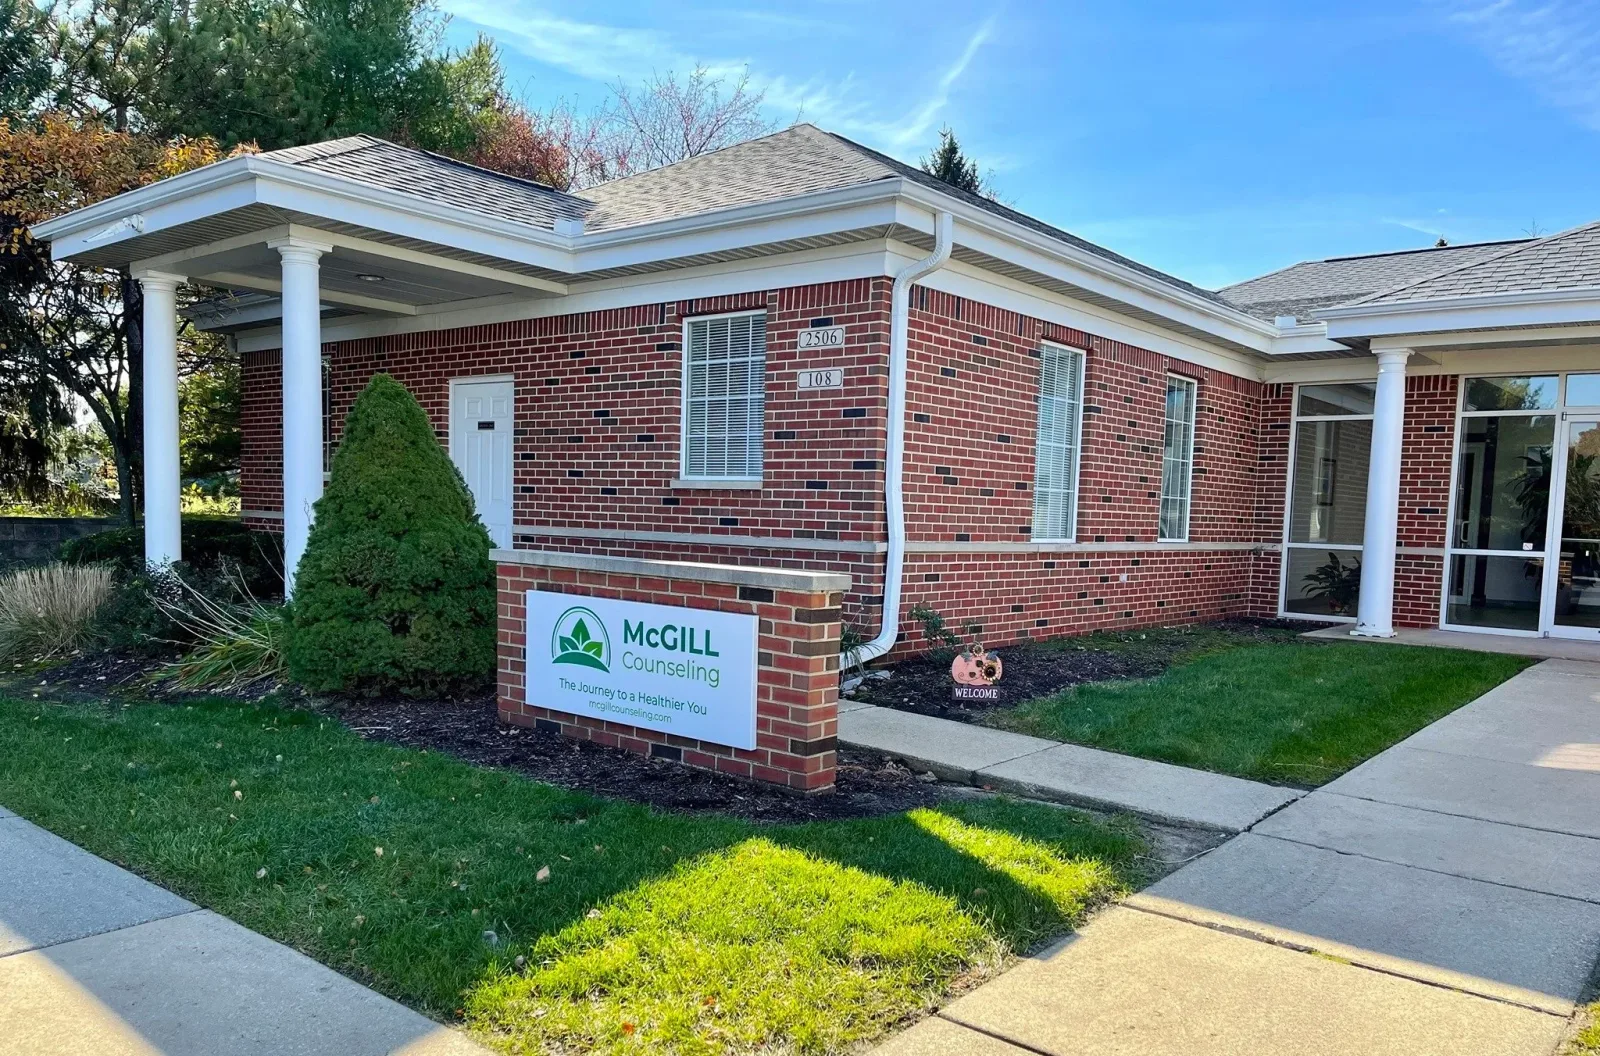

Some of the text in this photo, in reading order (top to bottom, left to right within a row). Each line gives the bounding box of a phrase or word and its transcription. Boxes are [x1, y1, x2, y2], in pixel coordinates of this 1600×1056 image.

[805, 330, 837, 346] 2506
[808, 371, 832, 387] 108
[623, 619, 720, 657] McGILL
[622, 651, 720, 688] Counseling
[559, 677, 707, 716] The Journey to a Healthier You
[954, 687, 998, 699] WELCOME
[588, 700, 672, 723] mcgillcounseling.com
